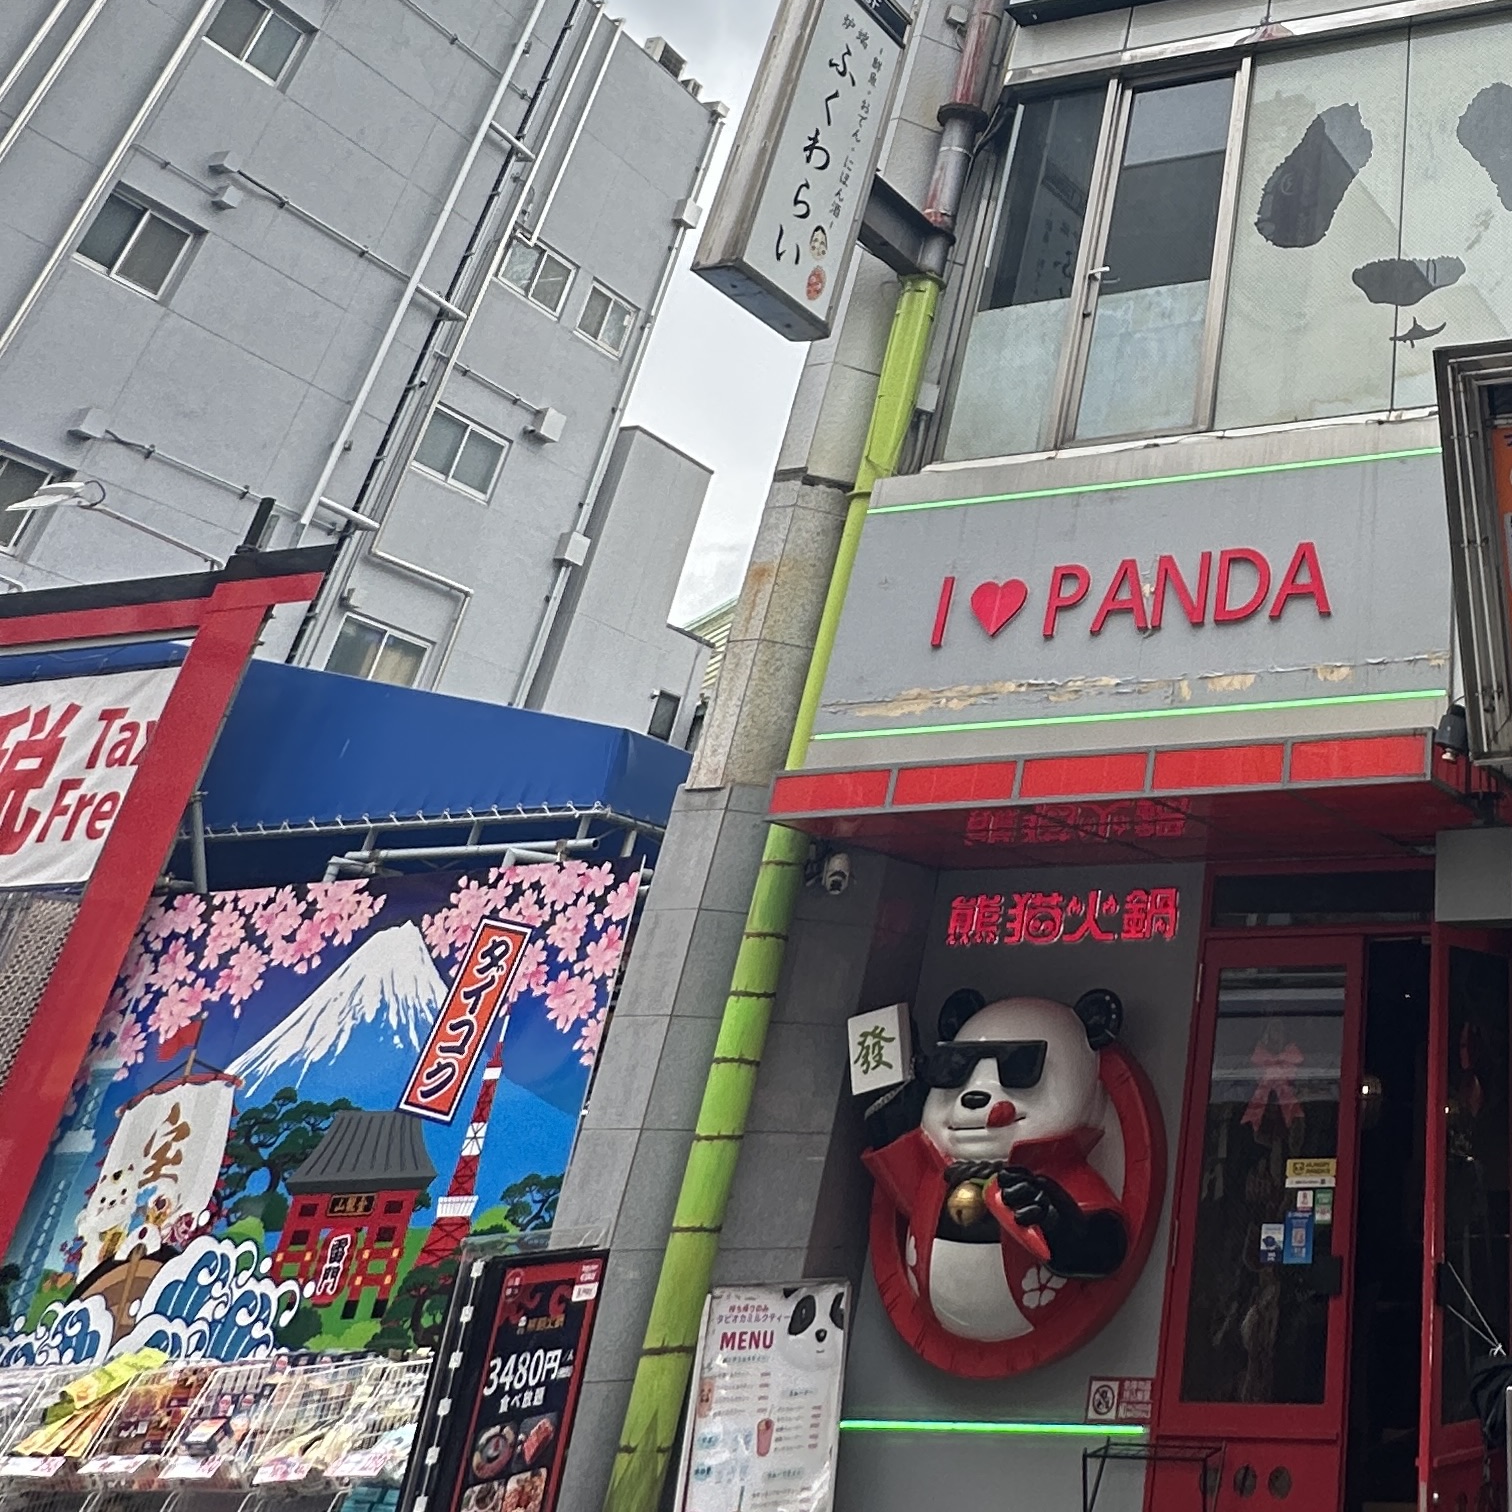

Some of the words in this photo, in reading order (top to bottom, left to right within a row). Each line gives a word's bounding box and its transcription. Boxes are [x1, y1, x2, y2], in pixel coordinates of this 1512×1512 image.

[774, 43, 857, 266] ふくわらい
[930, 576, 956, 649] I
[1042, 540, 1333, 640] PANDA
[36, 777, 123, 843] Fre
[946, 886, 1181, 947] 熊猫火鍋
[419, 937, 511, 1100] ダイコク
[853, 1025, 897, 1076] 發
[316, 1234, 351, 1295] 雷門
[719, 1329, 775, 1352] MENU
[483, 1348, 562, 1396] 3480円
[498, 1385, 547, 1414] 食べ放題
